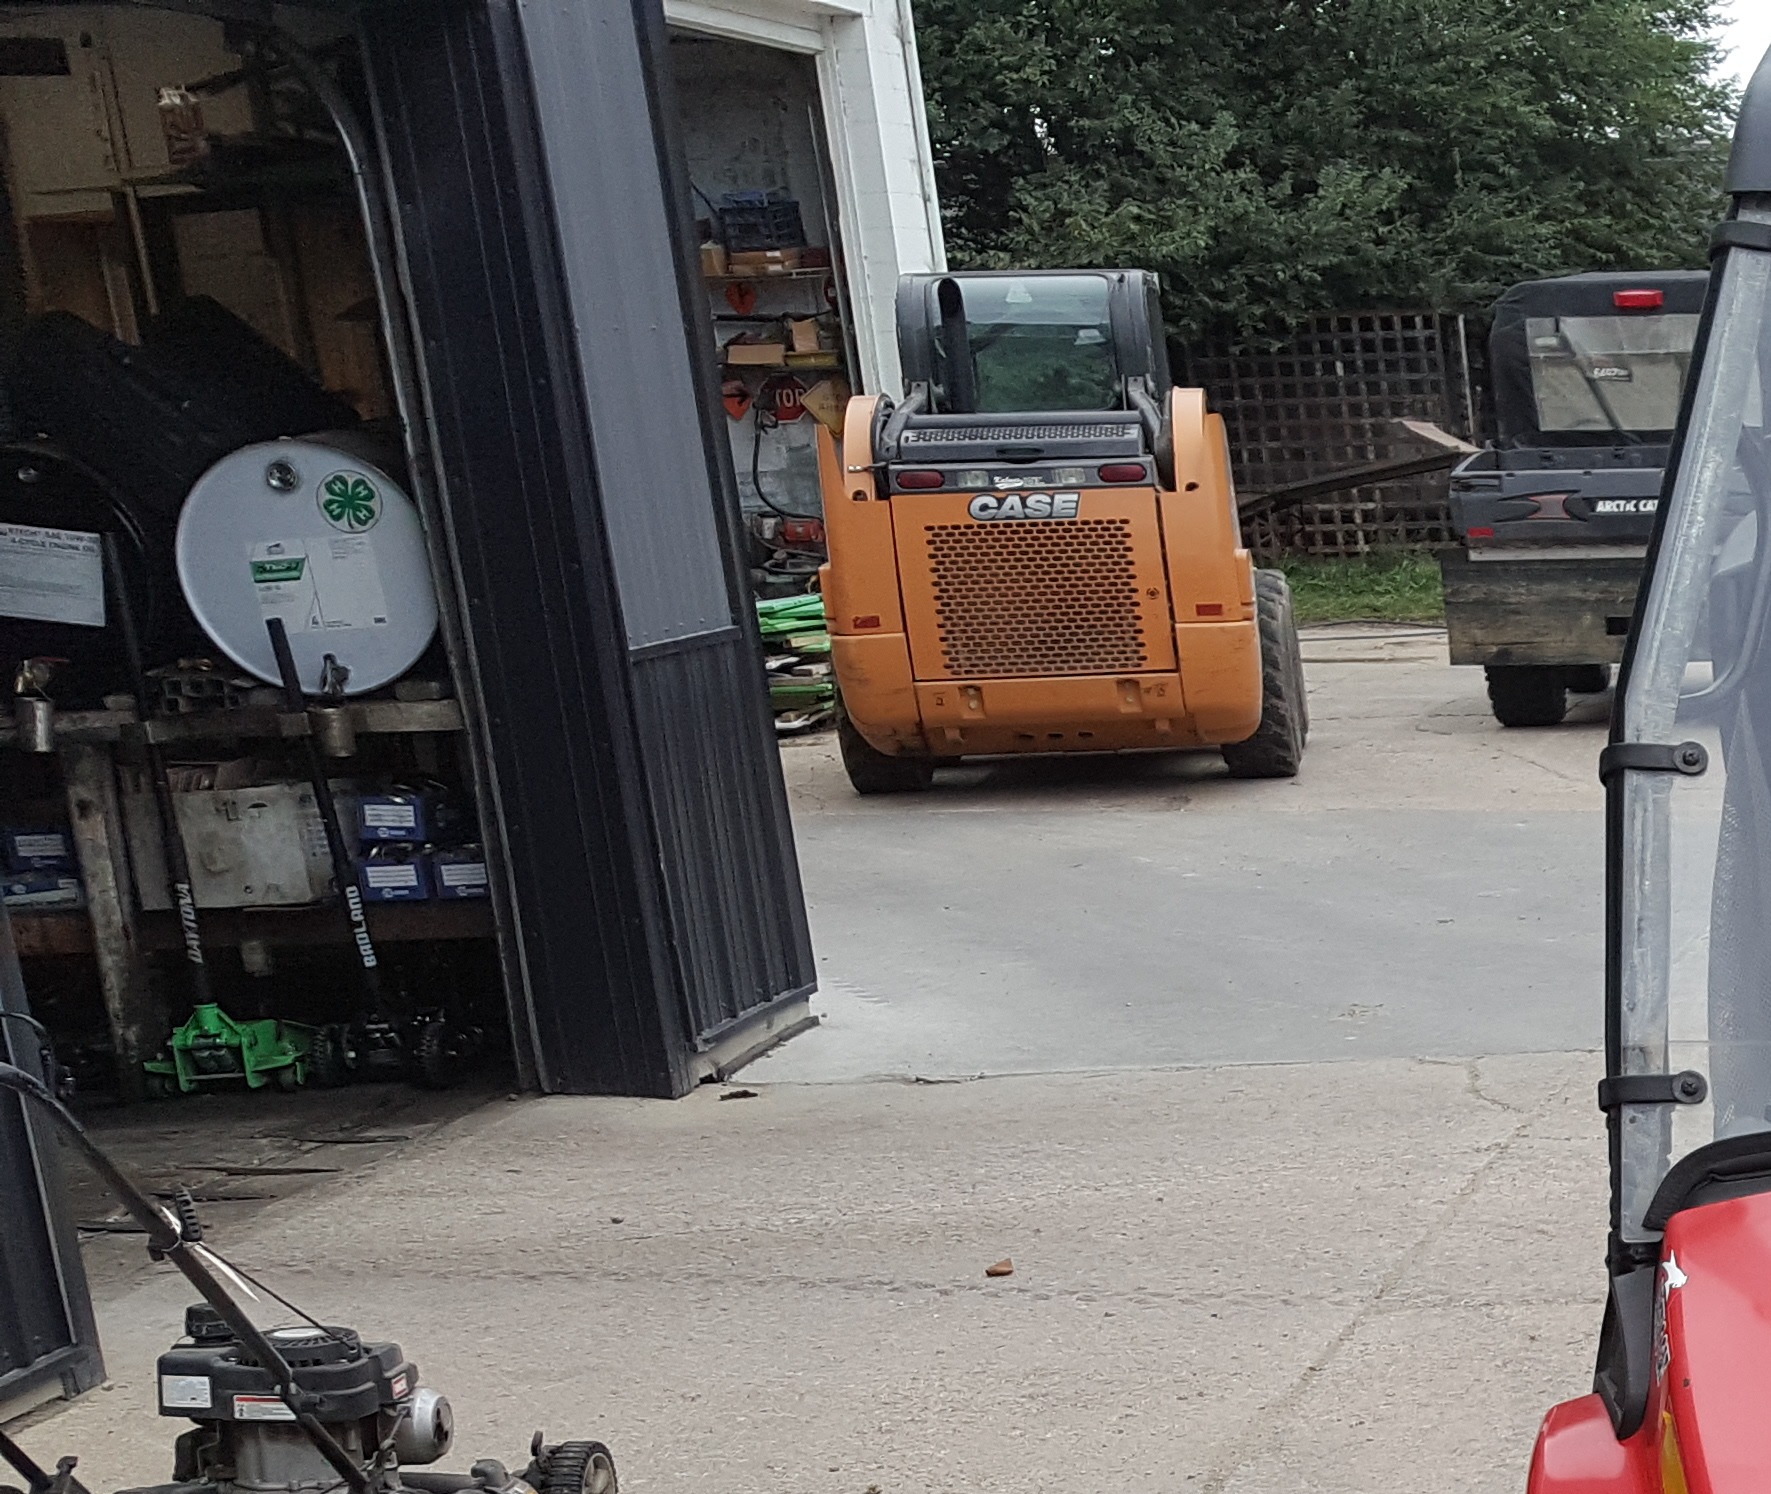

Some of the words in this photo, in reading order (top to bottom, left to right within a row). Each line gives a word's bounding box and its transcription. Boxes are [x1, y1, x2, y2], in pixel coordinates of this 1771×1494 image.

[772, 387, 805, 408] TOP
[969, 493, 1079, 520] CASE
[1595, 500, 1637, 512] ARCTIC
[174, 882, 204, 964] DAYTONA
[345, 885, 378, 968] BADLAND
